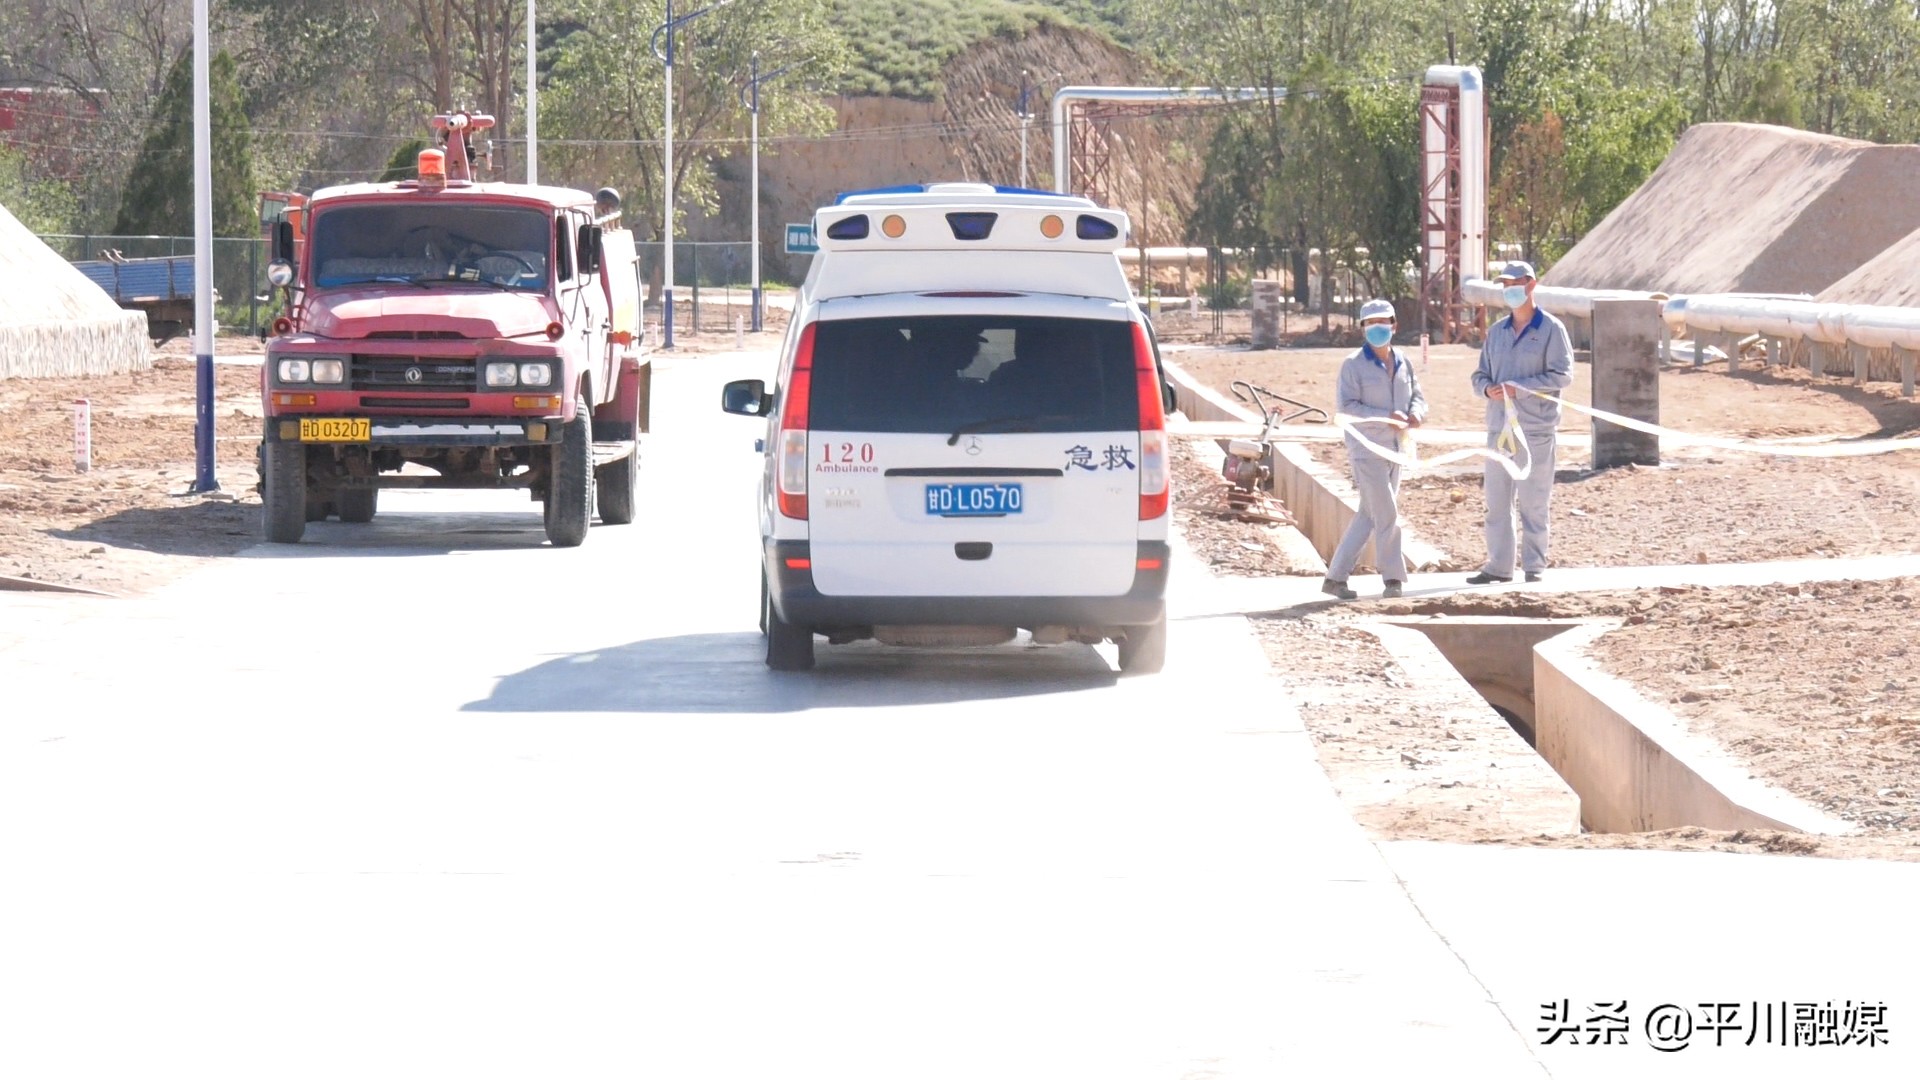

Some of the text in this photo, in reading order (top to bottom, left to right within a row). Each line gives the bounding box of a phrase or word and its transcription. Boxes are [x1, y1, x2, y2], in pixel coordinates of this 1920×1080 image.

[823, 442, 874, 463] 120
[1064, 444, 1136, 471] 急救
[815, 463, 879, 473] Ambulance
